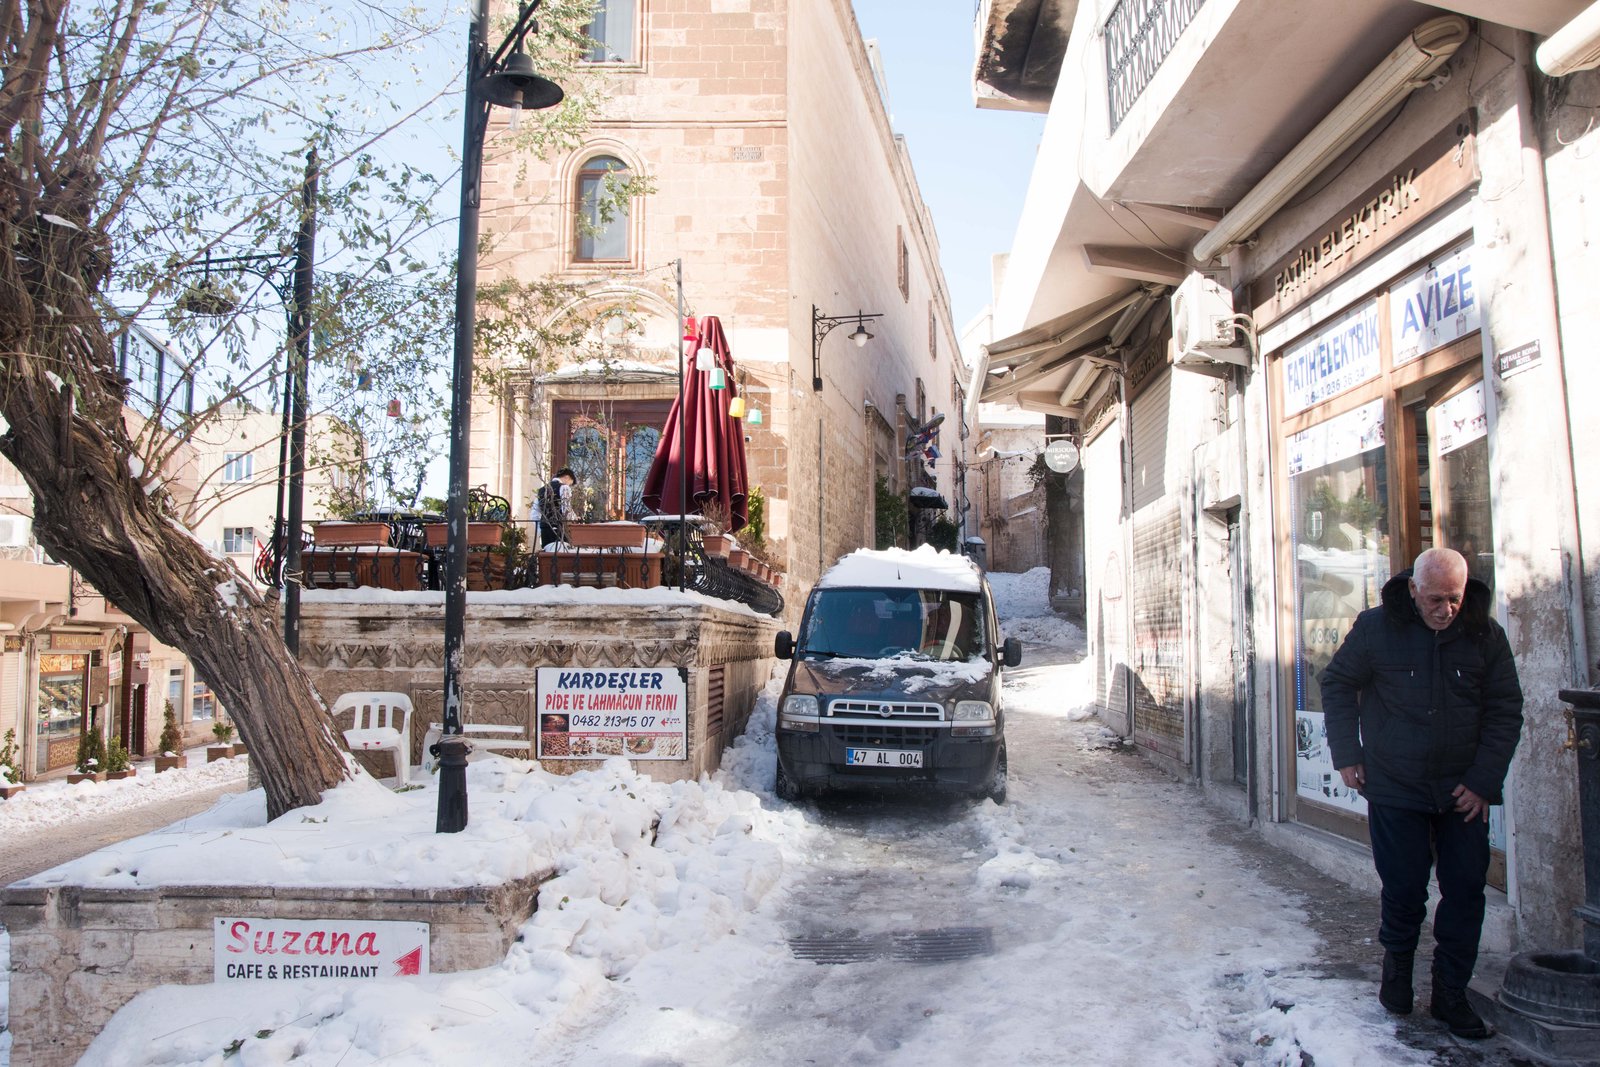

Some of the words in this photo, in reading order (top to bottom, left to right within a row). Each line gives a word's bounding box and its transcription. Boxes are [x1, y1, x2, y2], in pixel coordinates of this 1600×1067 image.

[1320, 168, 1419, 269] ELEKTRİK
[1401, 264, 1474, 339] AVİZE
[1320, 311, 1380, 378] ELEKTRİK
[557, 672, 663, 693] KARDEŞLER
[545, 691, 569, 710] PİDE
[572, 694, 585, 710] VE
[587, 694, 643, 711] LAHMACUN
[645, 694, 678, 711] FIRINI
[572, 715, 601, 727] 0482
[603, 715, 622, 728] 213
[625, 716, 637, 727] 15
[641, 716, 656, 727] 07
[853, 751, 867, 763] 47
[876, 752, 890, 764] AL
[899, 753, 920, 765] 004
[226, 920, 380, 957] Suzana
[227, 963, 263, 979] CAFE
[267, 964, 278, 979] &
[283, 964, 378, 979] RESTAURANT
